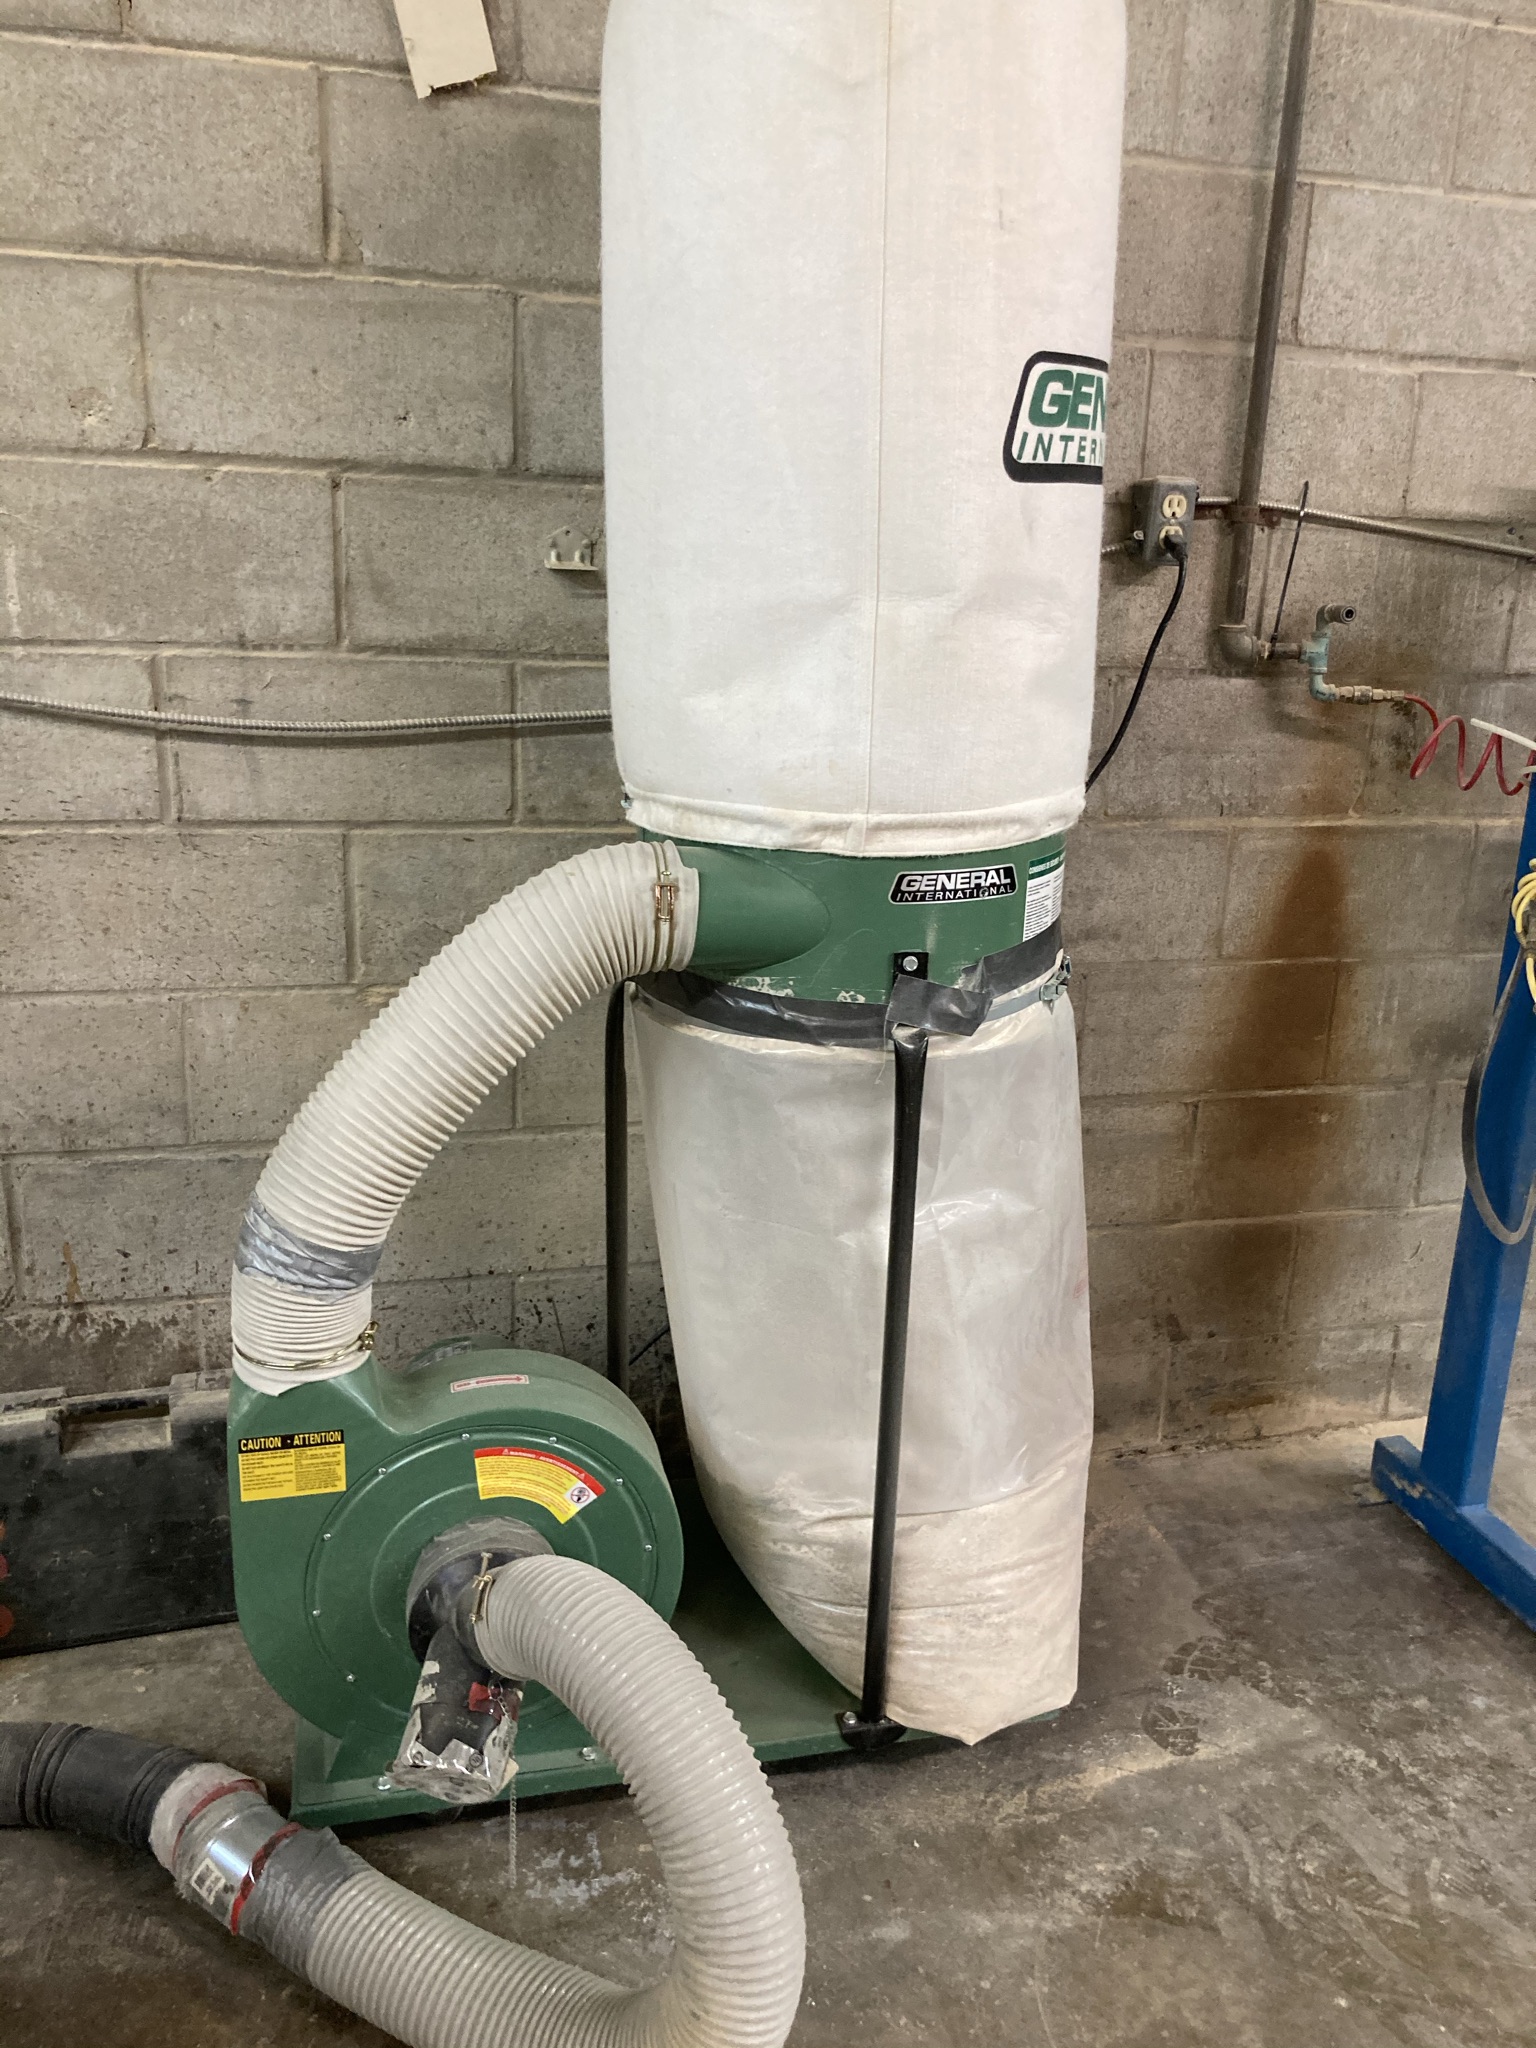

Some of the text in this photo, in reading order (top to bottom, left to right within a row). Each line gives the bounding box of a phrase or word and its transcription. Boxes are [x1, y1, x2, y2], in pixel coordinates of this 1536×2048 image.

[900, 868, 1011, 892] GENERAL
[896, 884, 1013, 902] INTERNATIONAL
[240, 1436, 282, 1451] CAUTION
[293, 1431, 342, 1446] ATTENTION
